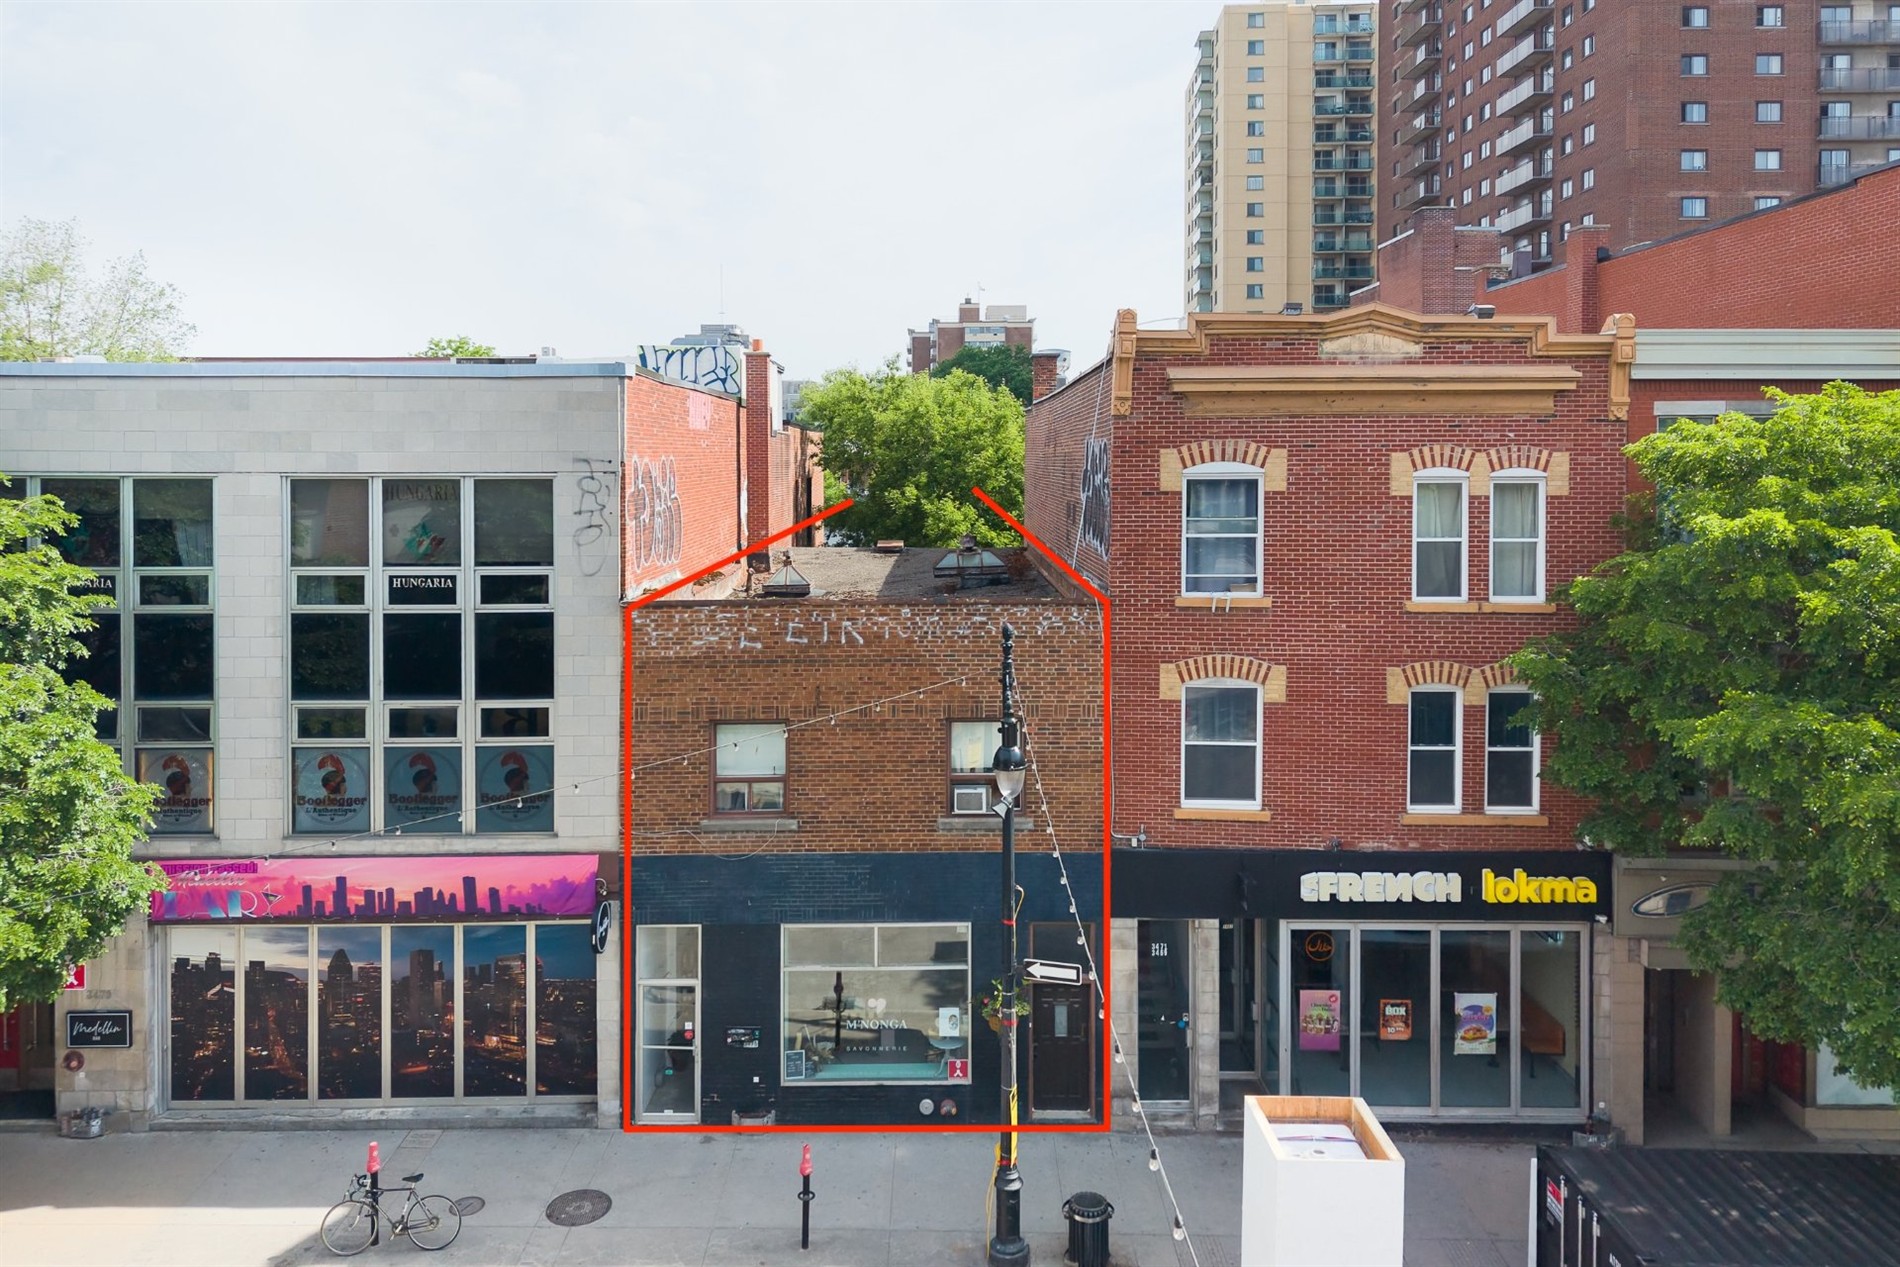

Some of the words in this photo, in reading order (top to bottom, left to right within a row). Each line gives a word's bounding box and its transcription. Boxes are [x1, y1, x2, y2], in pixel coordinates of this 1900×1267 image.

[384, 485, 459, 501] HUNGARIA
[393, 578, 453, 588] HUNGARIA
[1482, 868, 1597, 903] lokma
[846, 1019, 908, 1030] M'NONGA
